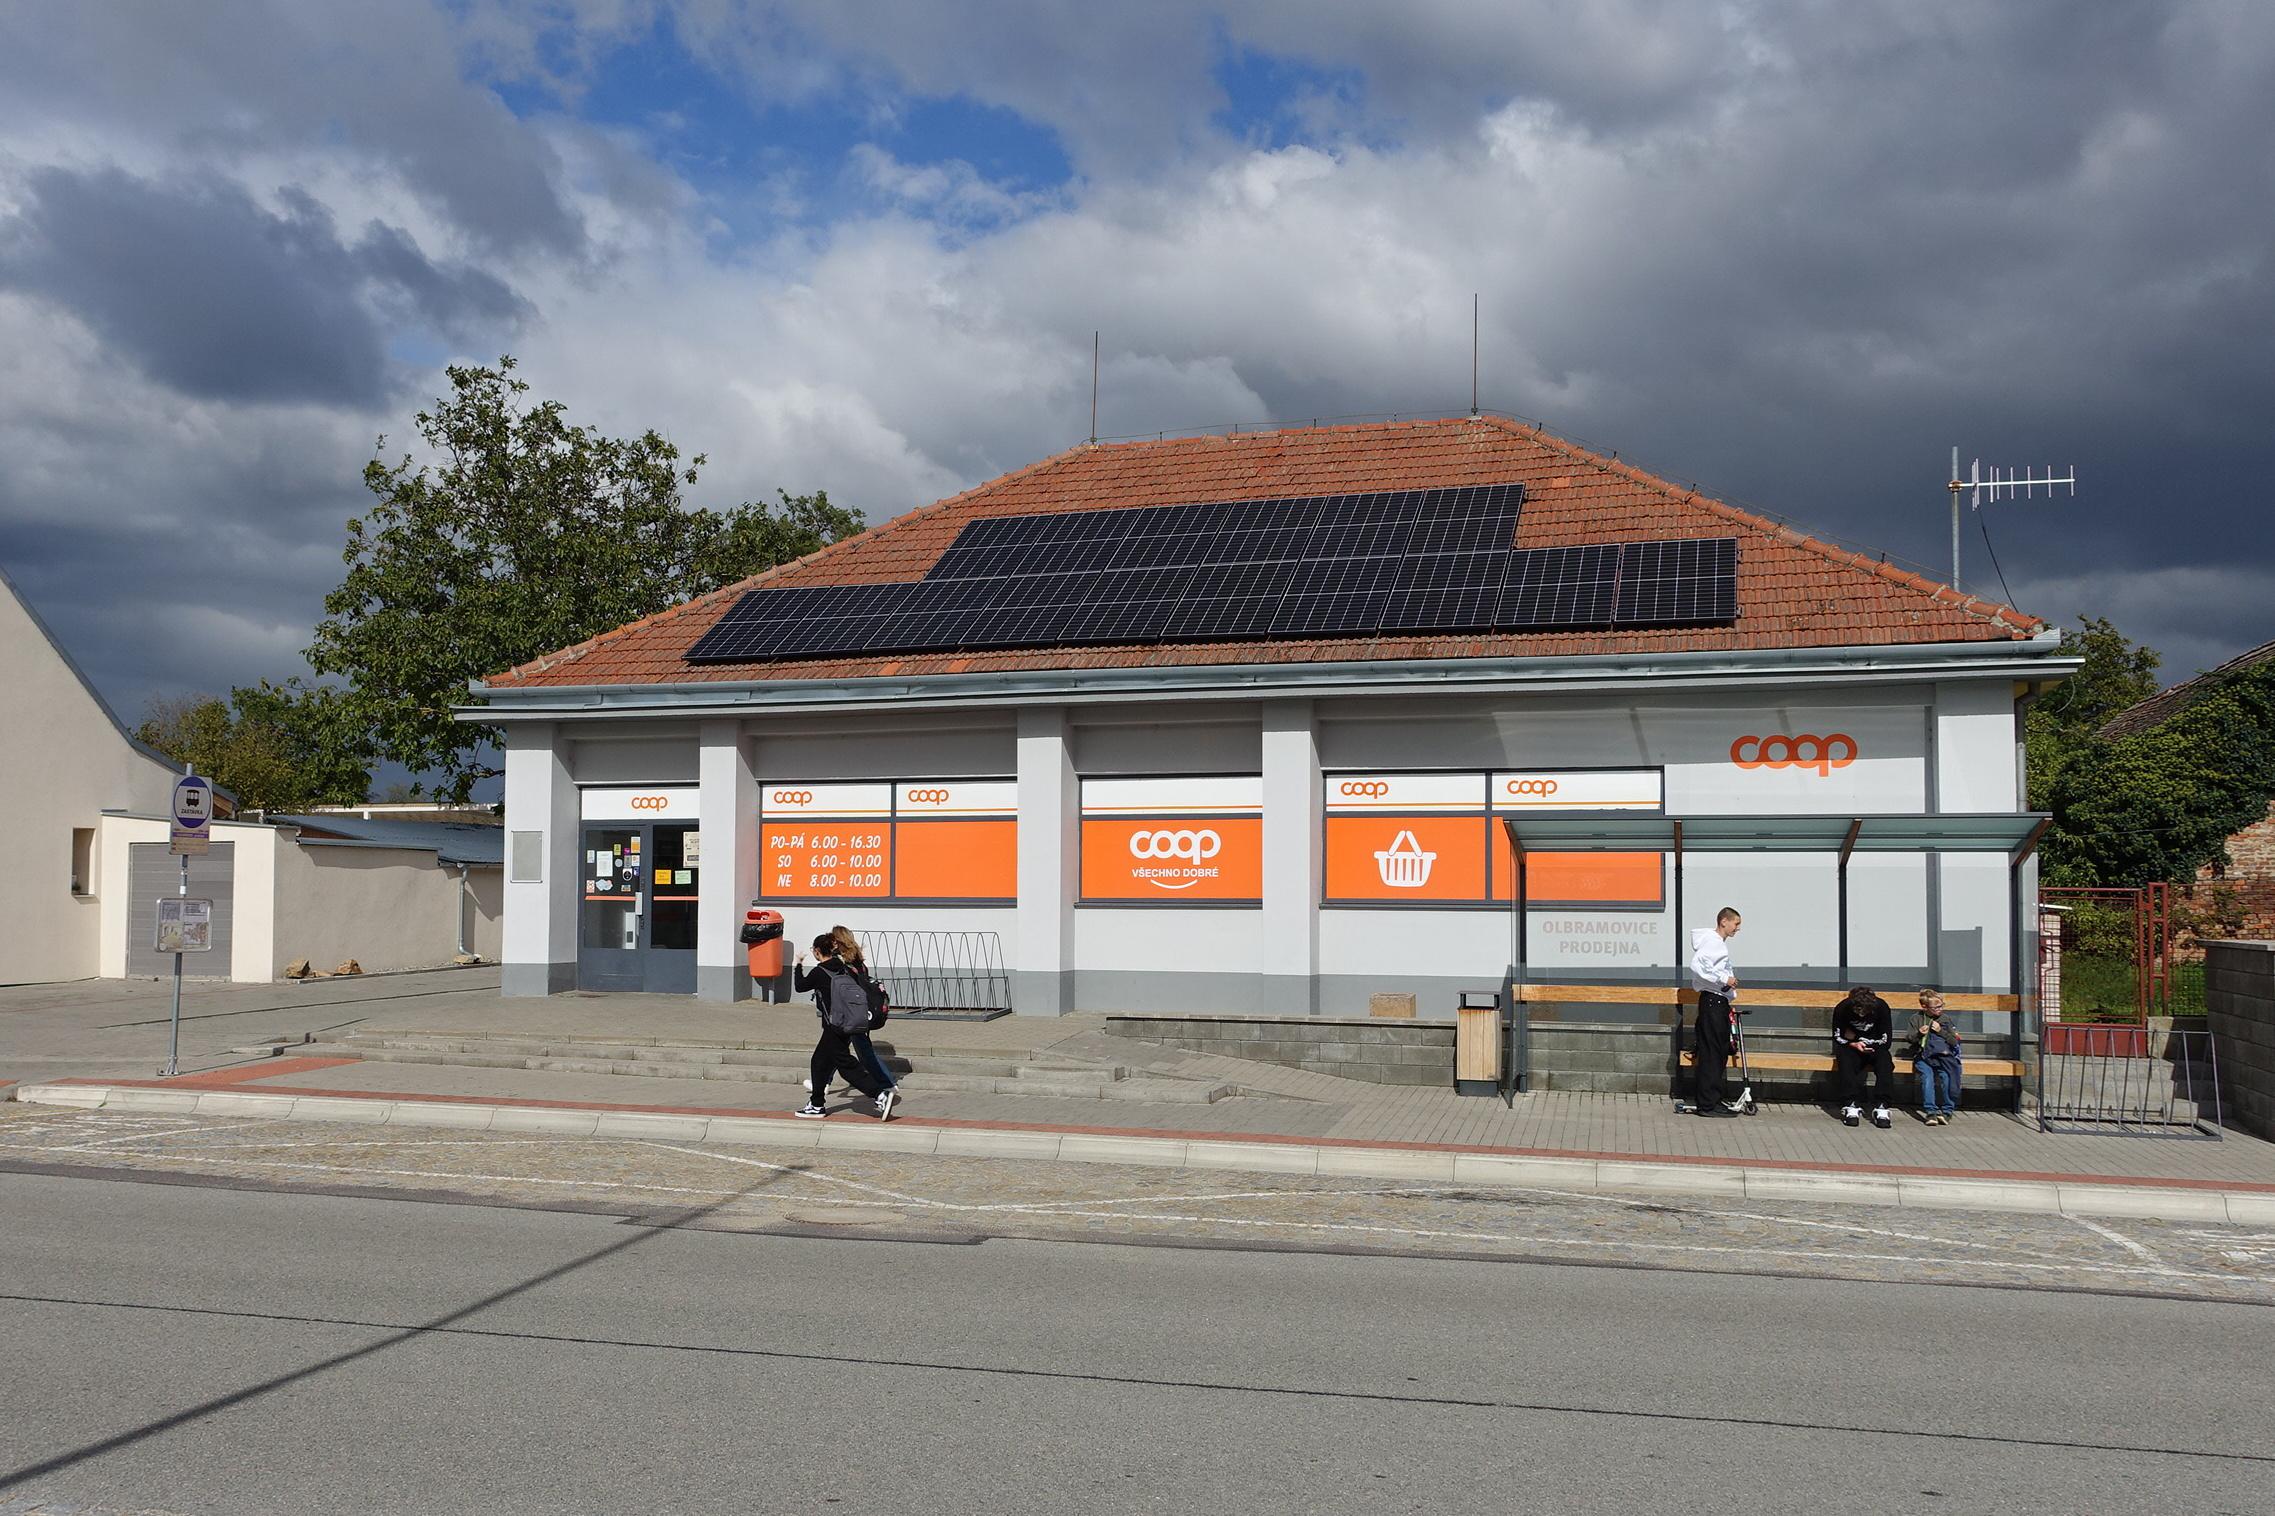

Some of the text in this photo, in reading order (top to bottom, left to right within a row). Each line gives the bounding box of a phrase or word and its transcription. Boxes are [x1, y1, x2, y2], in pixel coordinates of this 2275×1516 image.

[1729, 733, 1858, 778] coop
[1339, 781, 1389, 797] coop
[1506, 779, 1558, 795] coop
[631, 797, 668, 811] coop
[773, 791, 813, 806] coop
[908, 789, 949, 805] coop
[770, 832, 805, 849] PO-PÁ
[811, 835, 839, 849] 6.00
[850, 834, 882, 849] 16.30
[1129, 829, 1222, 866] coop
[777, 854, 792, 868] SO
[810, 854, 838, 868] 6.00
[849, 853, 882, 868] 10.00
[1131, 865, 1220, 878] VŠECHNO DOBRÉ
[777, 873, 793, 888] NE
[809, 873, 837, 888] 8.00
[849, 873, 882, 888] 10.00
[1542, 920, 1658, 935] OLBRAMOVICE
[1559, 940, 1641, 957] PRODEJNA
